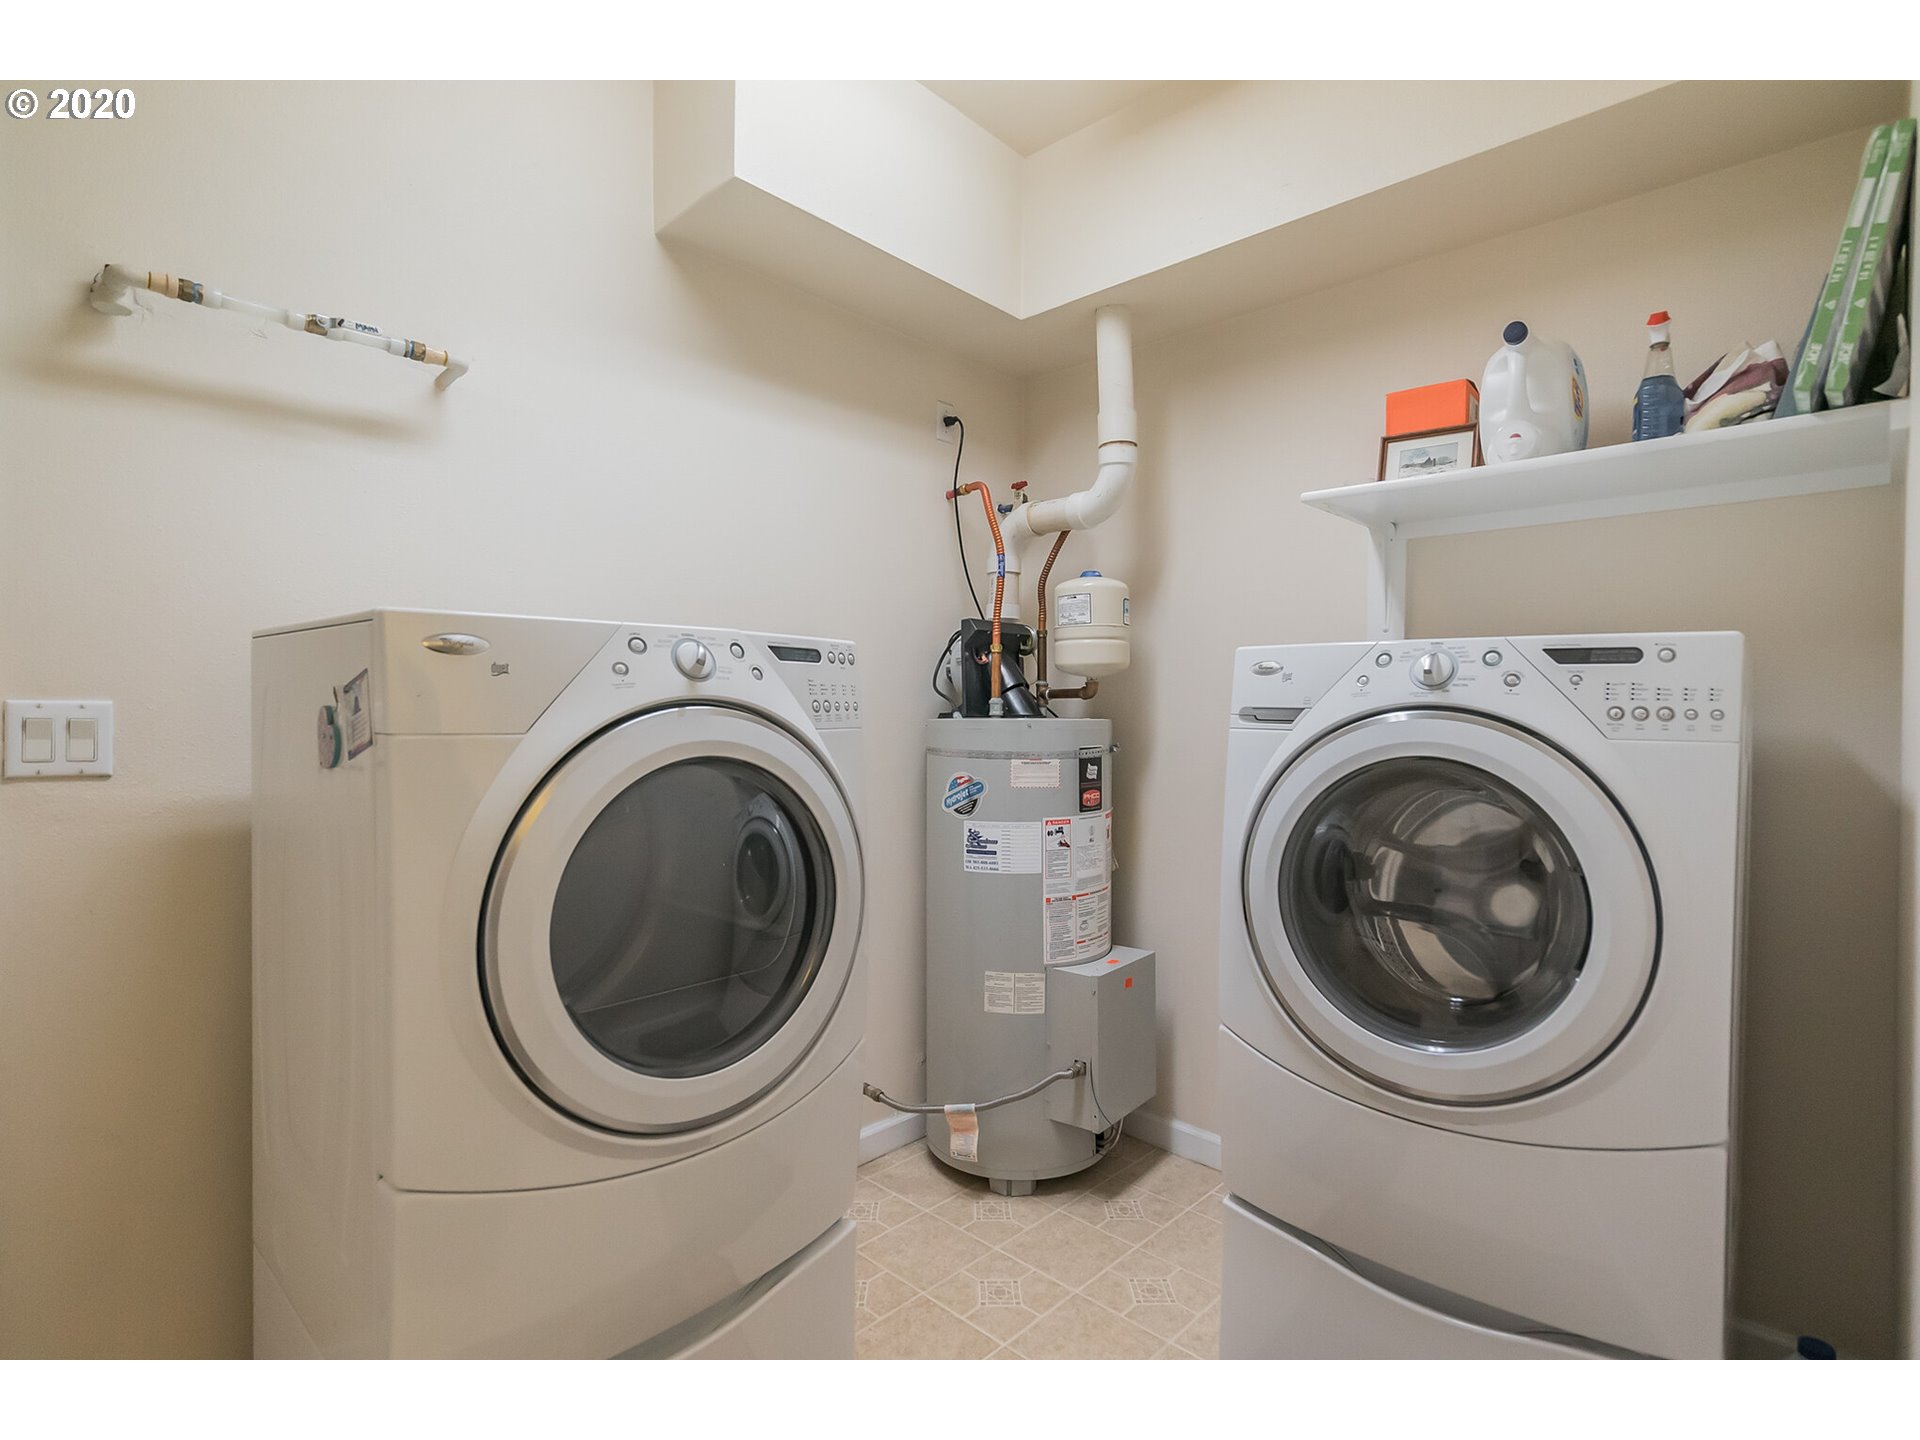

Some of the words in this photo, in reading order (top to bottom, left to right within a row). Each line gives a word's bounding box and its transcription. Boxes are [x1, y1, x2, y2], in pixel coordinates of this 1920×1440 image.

[355, 322, 379, 334] MAIN
[1805, 342, 1823, 366] ACE
[1837, 342, 1856, 366] ACE
